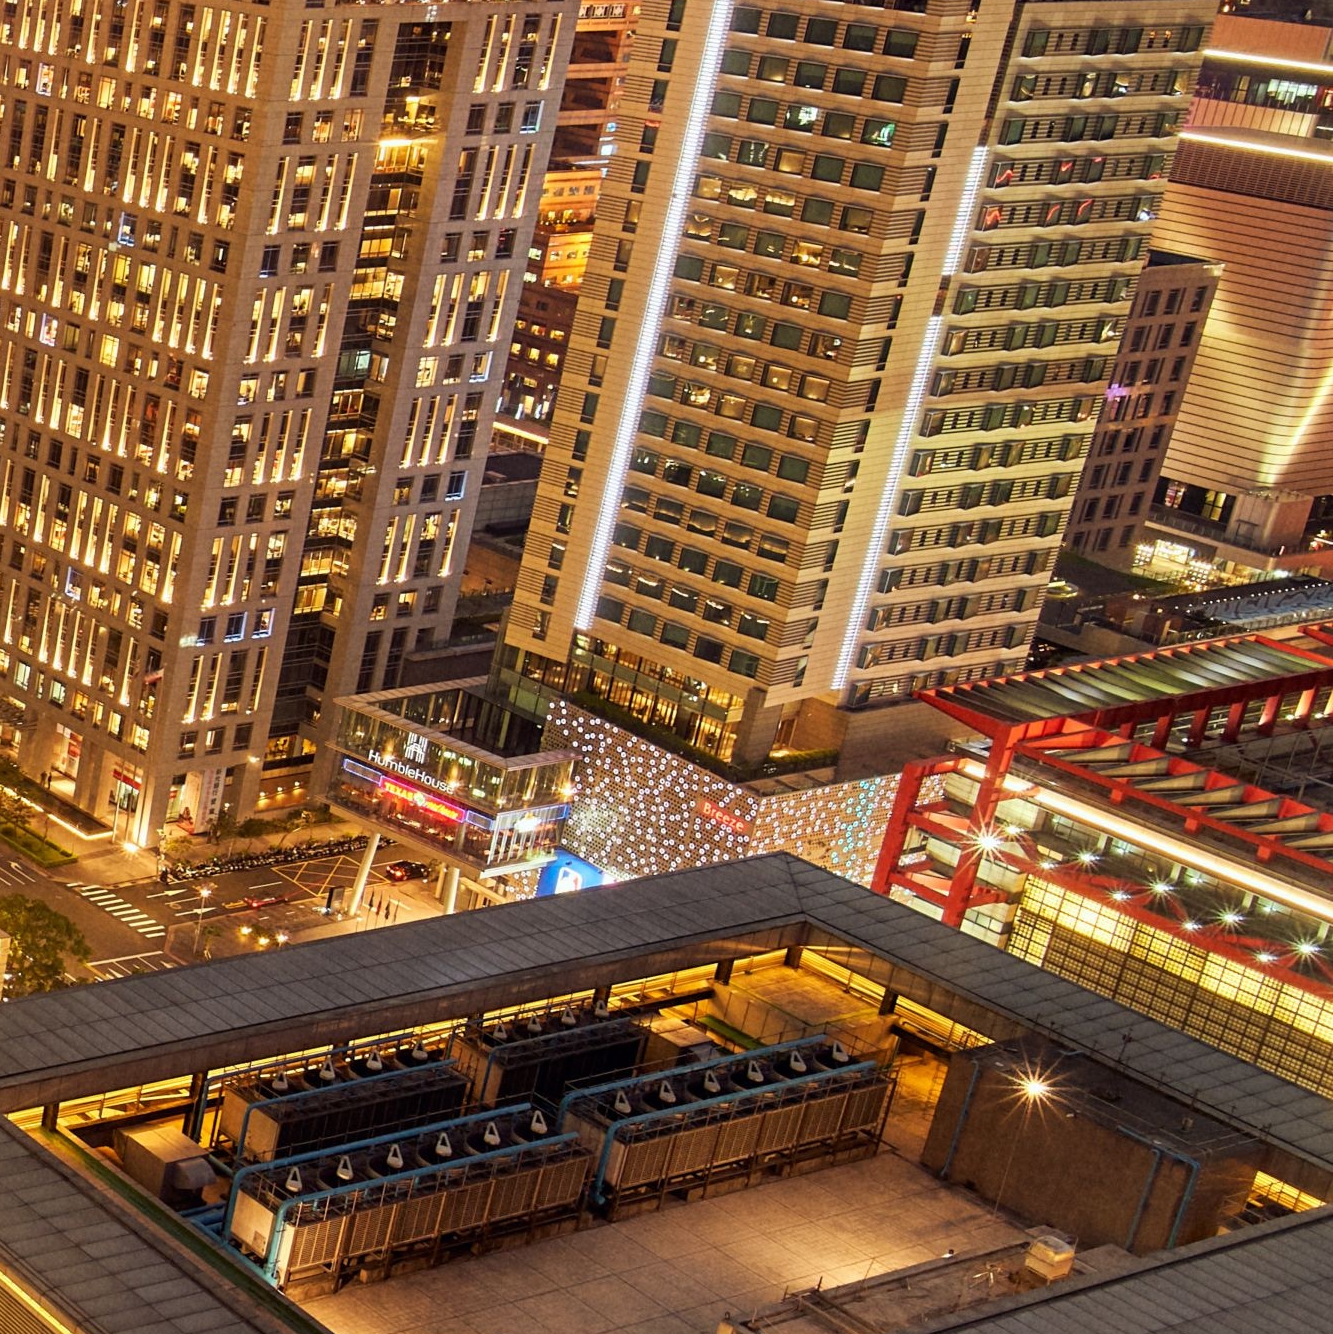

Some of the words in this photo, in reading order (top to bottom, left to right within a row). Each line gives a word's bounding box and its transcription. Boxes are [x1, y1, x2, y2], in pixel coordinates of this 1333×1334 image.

[368, 749, 454, 794] HumbleHouse
[384, 781, 414, 801] TEXAS
[703, 801, 745, 832] Breeze
